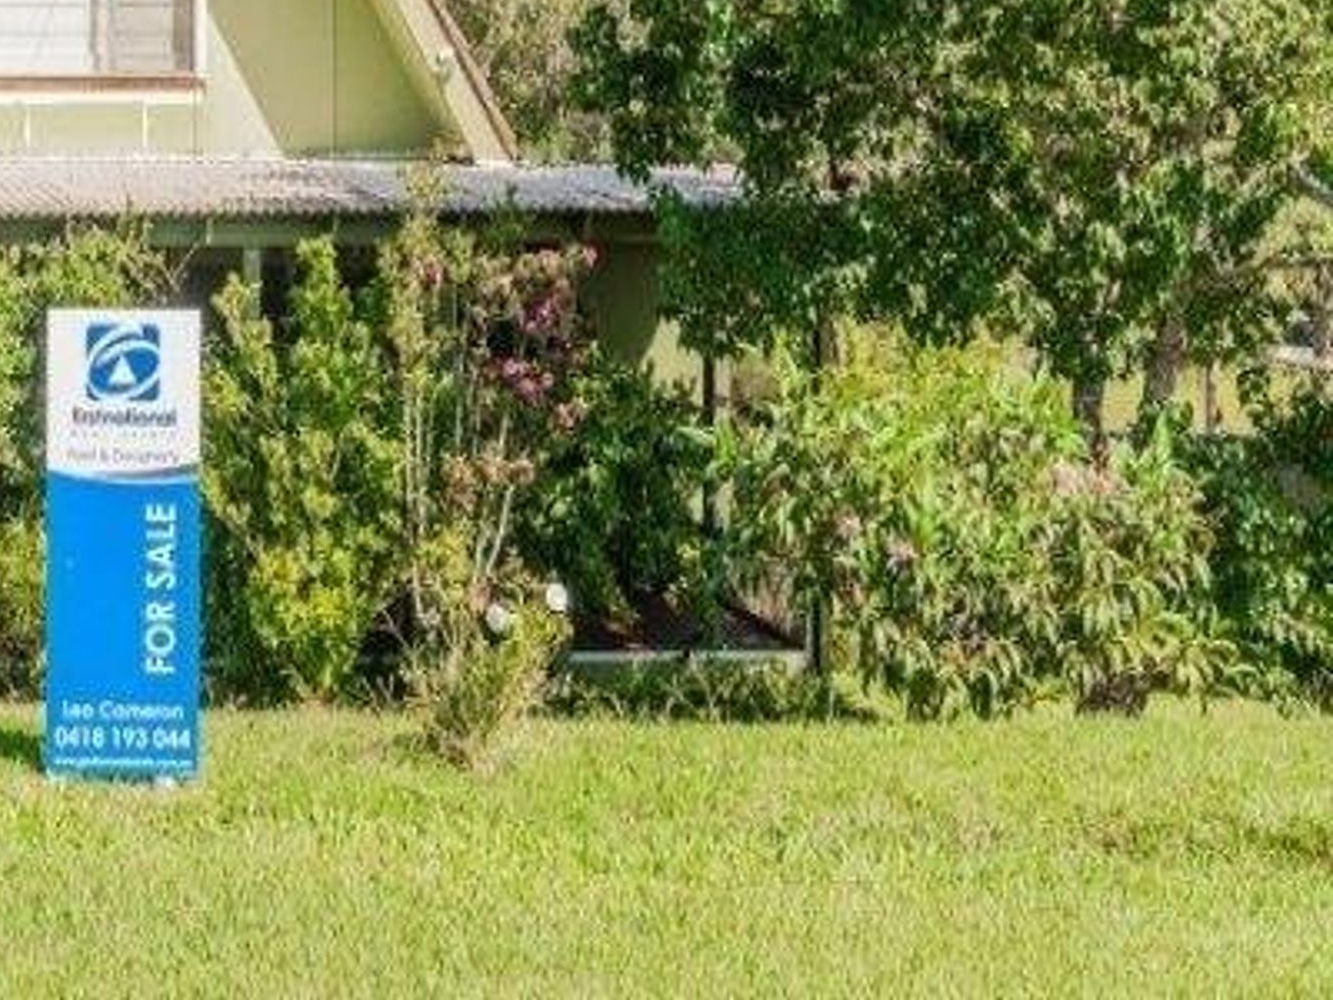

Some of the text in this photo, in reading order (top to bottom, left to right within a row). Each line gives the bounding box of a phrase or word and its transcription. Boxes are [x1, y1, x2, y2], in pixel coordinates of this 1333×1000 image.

[145, 503, 177, 675] FOR SALE
[98, 700, 184, 719] Cameron
[55, 726, 191, 749] 0418 193 044
